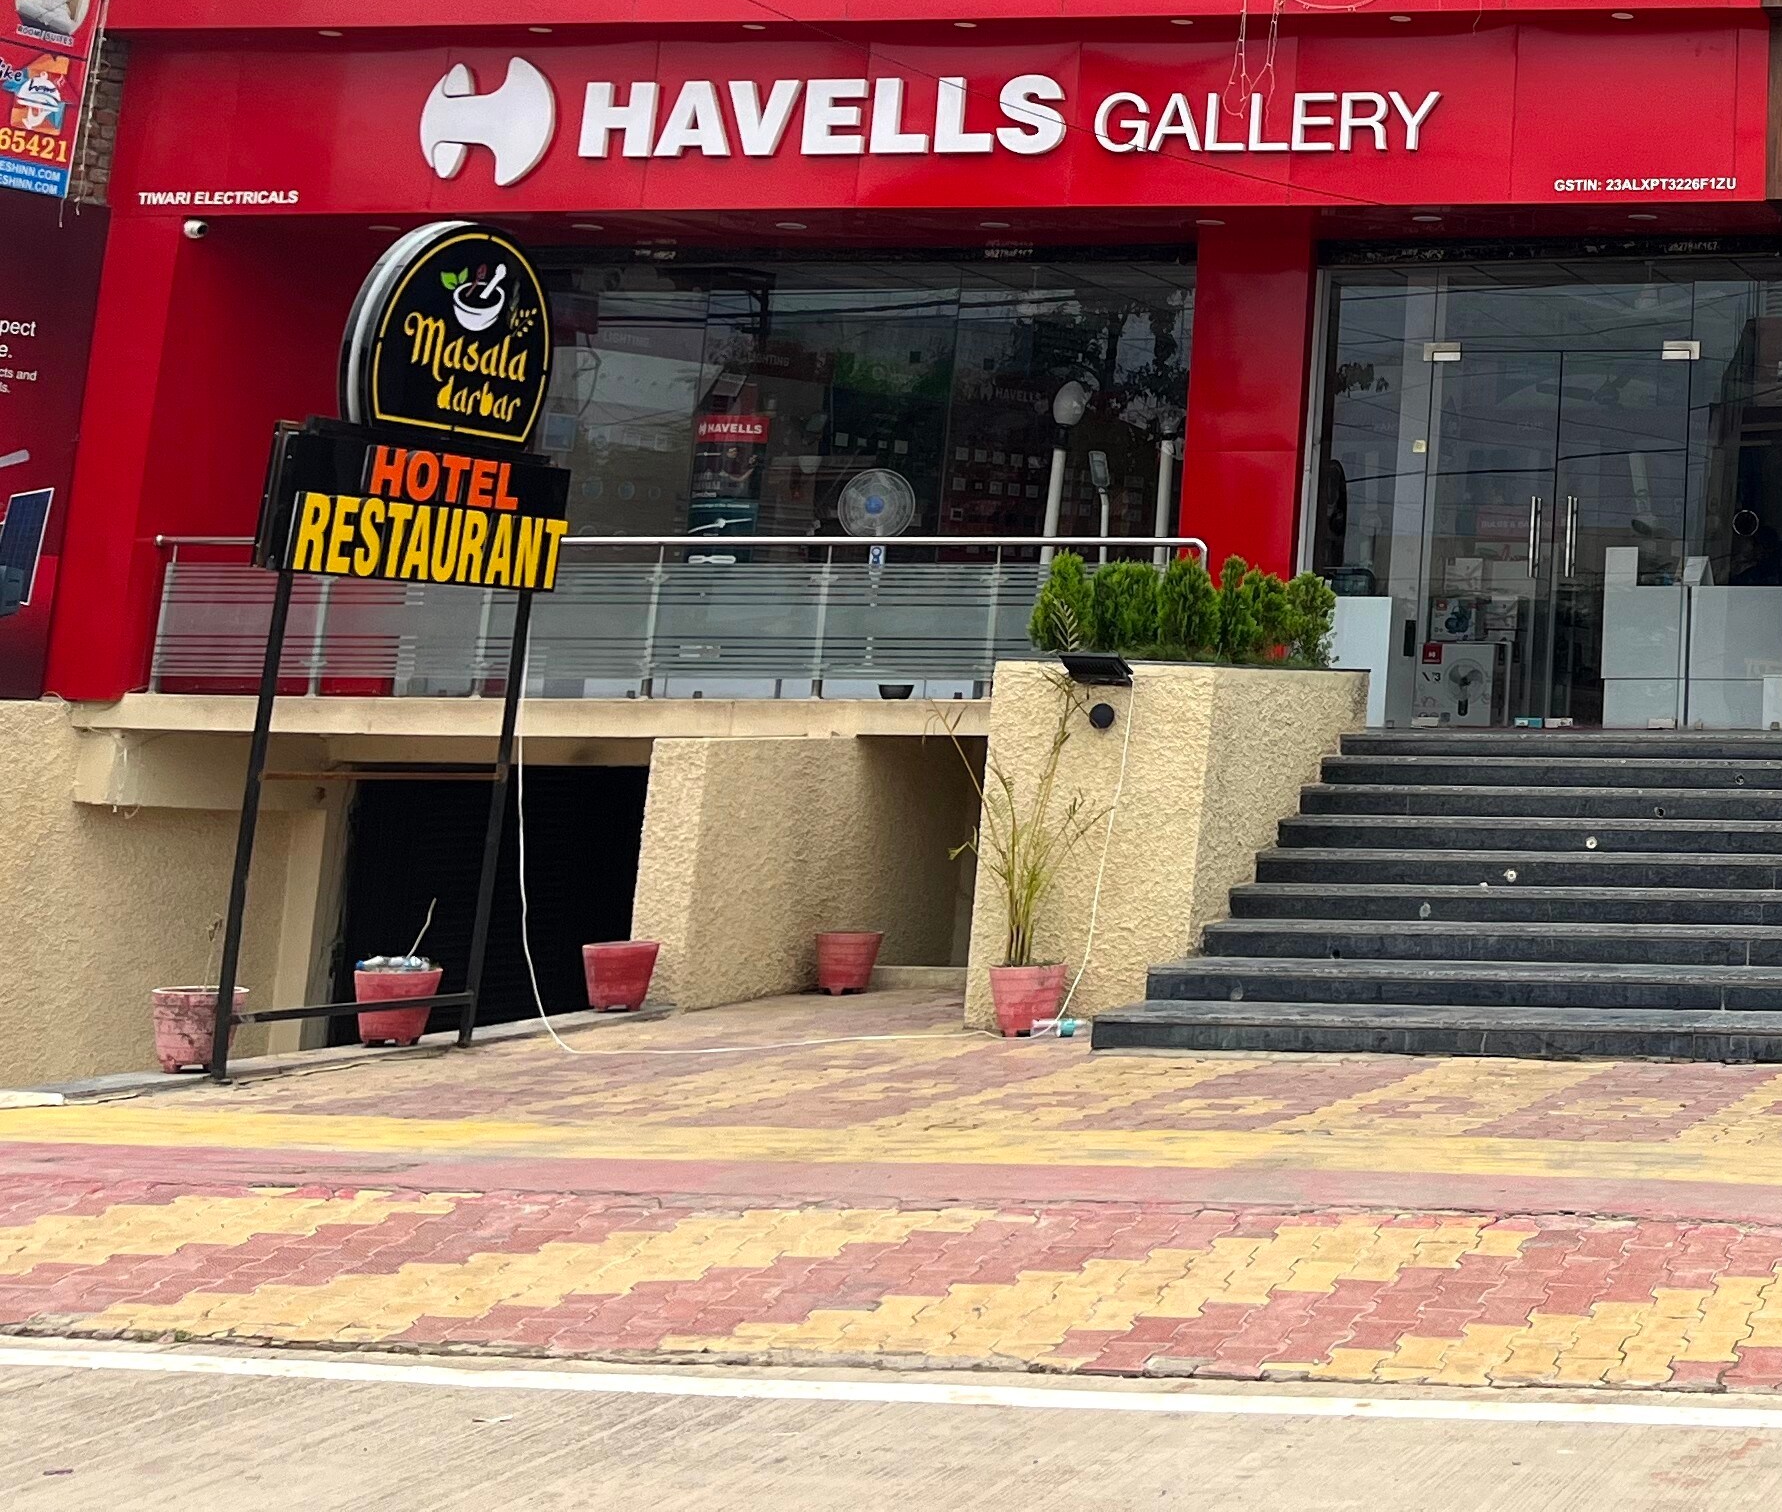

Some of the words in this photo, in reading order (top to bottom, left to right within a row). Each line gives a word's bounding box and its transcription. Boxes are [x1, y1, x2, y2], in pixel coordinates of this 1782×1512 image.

[578, 74, 1067, 159] HAVELLS
[1093, 90, 1442, 154] GALLERY
[0, 127, 67, 162] 65421
[138, 191, 191, 205] TIWARI
[194, 190, 299, 205] ELECTRICALS
[1554, 179, 1602, 191] GSTIN:
[1605, 178, 1737, 191] 23ALXPT3226F1ZU
[404, 311, 528, 382] Masala
[16, 370, 37, 381] and
[436, 381, 521, 422] darbar
[708, 423, 763, 434] HAVELLS
[369, 444, 519, 511] HOTEL
[291, 492, 569, 590] RESTAURANT
